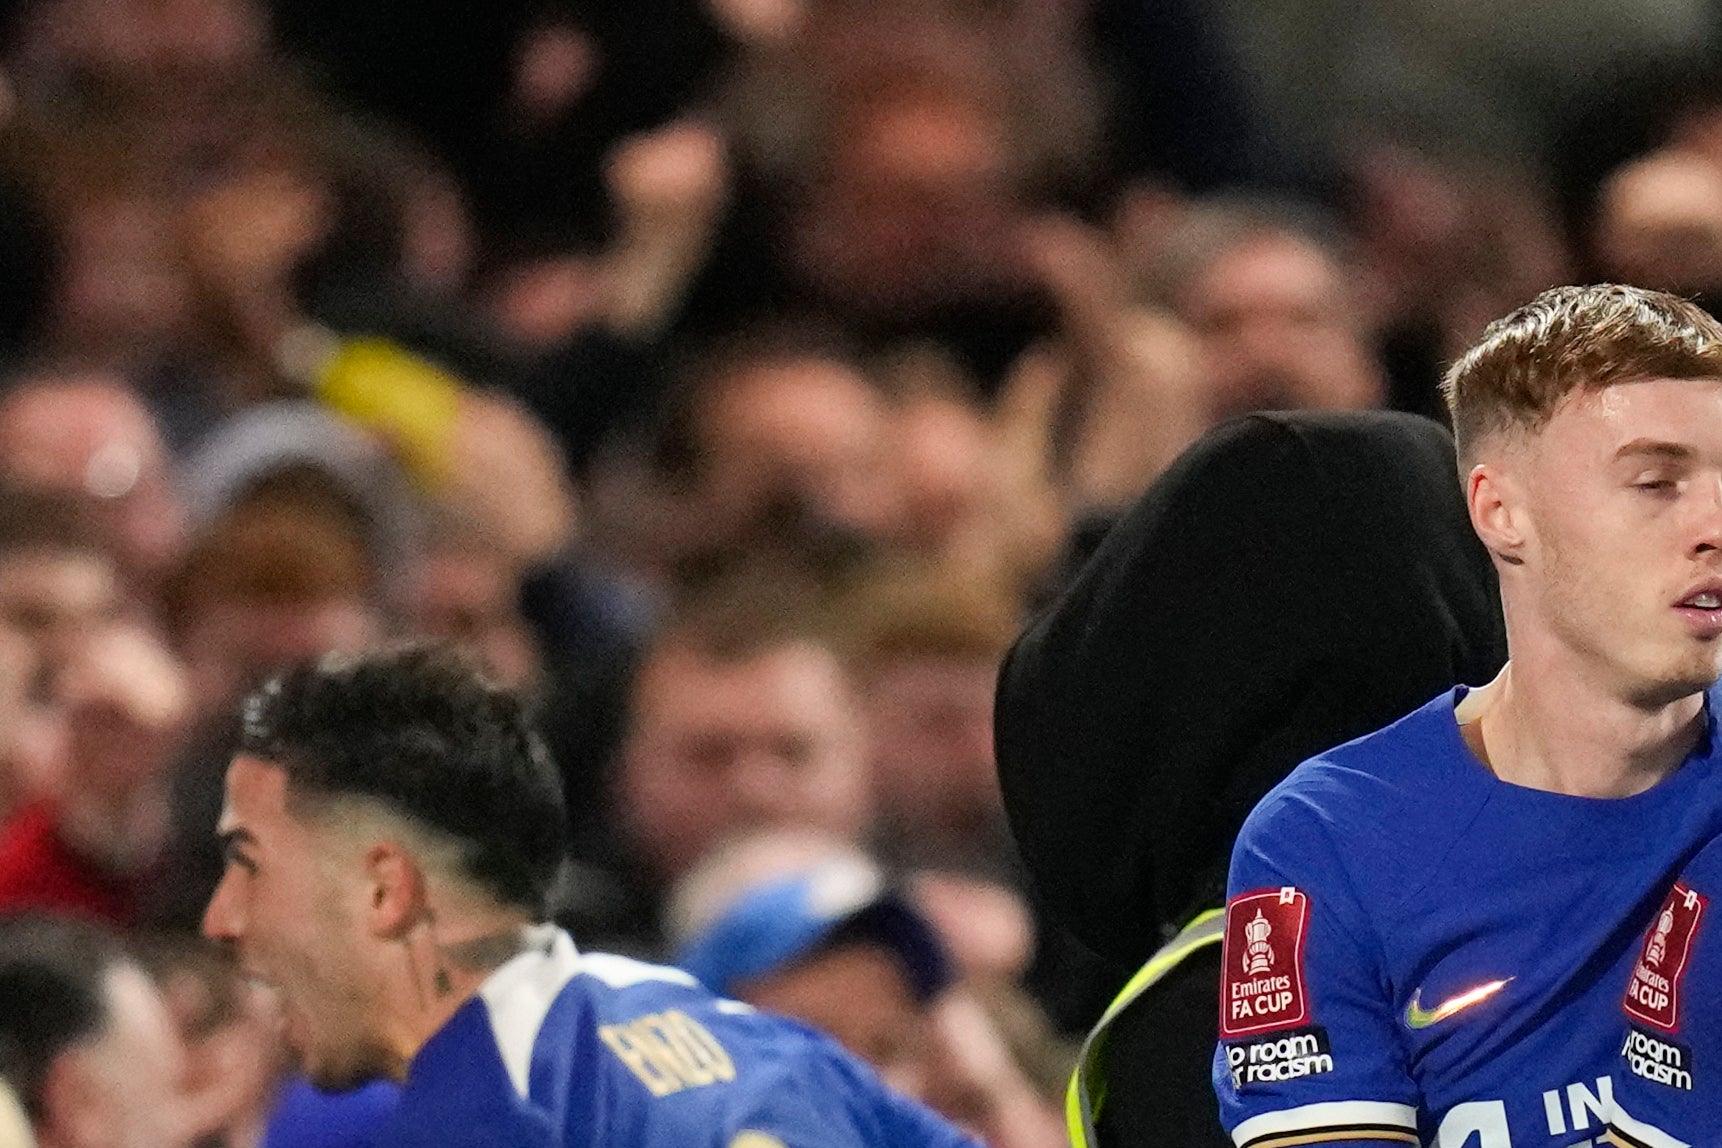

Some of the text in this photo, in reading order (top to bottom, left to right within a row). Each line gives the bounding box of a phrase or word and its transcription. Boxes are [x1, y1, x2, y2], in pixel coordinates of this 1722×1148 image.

[1231, 975, 1291, 1000] Emirates
[1639, 985, 1669, 1011] CUP
[1231, 991, 1294, 1020] FA CUP
[598, 1008, 737, 1098] ENZO
[1225, 1034, 1319, 1069] o room
[1630, 1030, 1681, 1067] room
[1246, 1053, 1333, 1082] racism
[1630, 1053, 1692, 1090] acism
